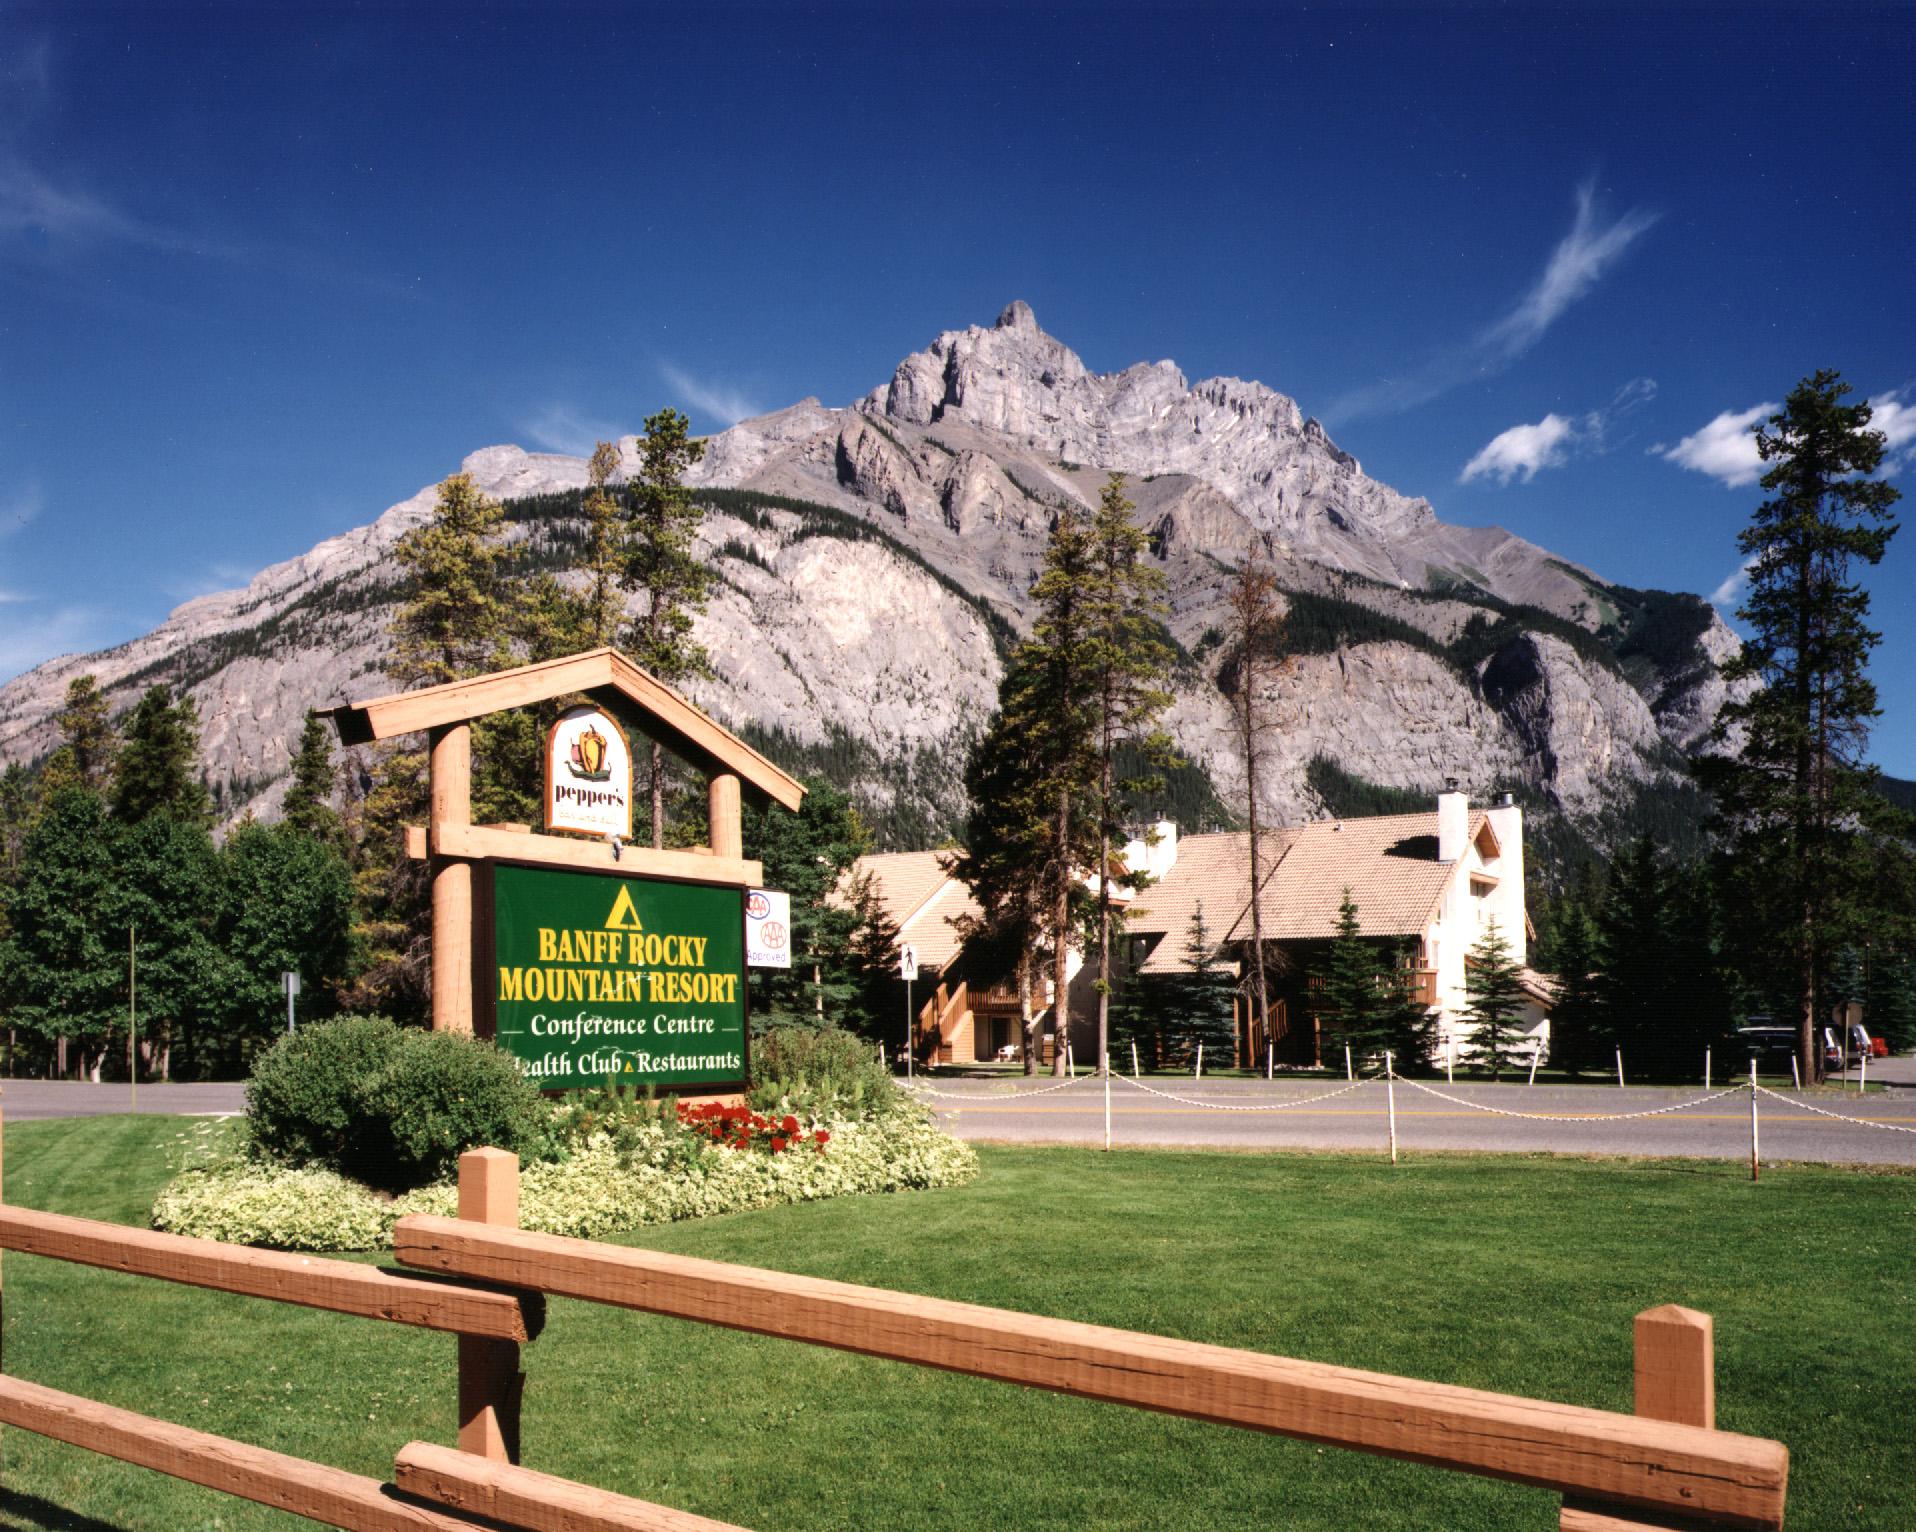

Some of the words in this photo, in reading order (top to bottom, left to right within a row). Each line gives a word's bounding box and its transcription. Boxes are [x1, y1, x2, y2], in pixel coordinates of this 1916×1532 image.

[556, 785, 624, 808] pepper's
[538, 928, 623, 963] BANFF
[628, 933, 708, 967] ROCKY
[499, 967, 642, 1002] MOUNTAIN
[648, 972, 738, 1003] RESORT
[531, 1011, 648, 1045] Conference
[653, 1014, 715, 1034] Centre
[577, 1050, 622, 1075] Club
[637, 1051, 741, 1073] Restaurants
